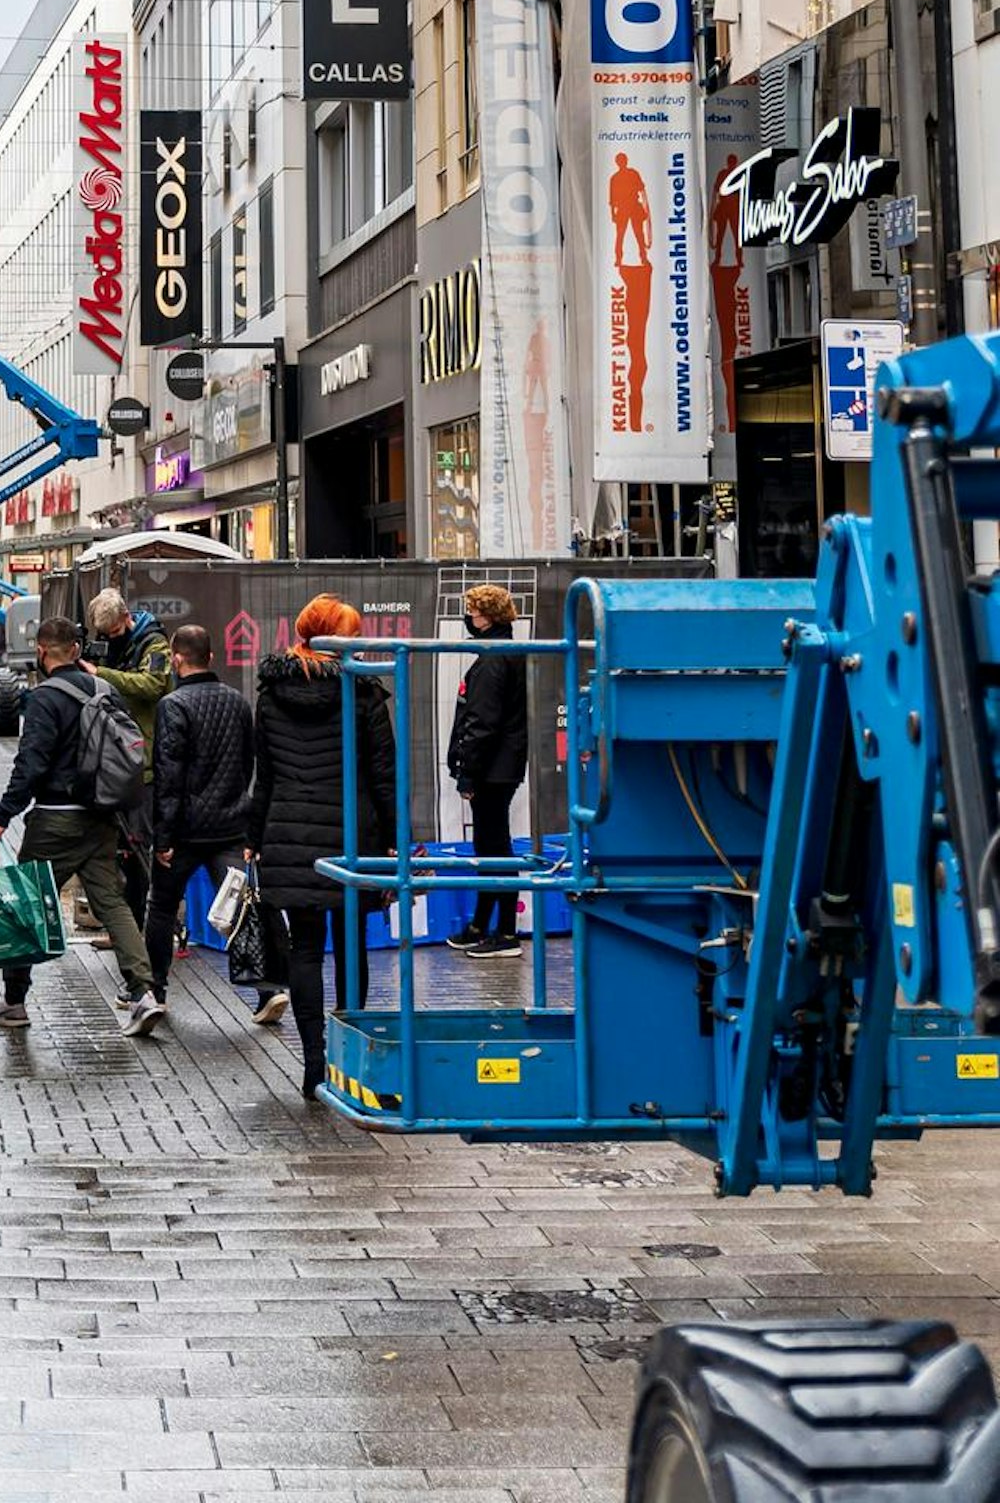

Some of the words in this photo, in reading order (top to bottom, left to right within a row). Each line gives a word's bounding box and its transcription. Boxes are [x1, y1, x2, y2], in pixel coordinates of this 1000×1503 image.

[309, 63, 403, 83] CALLAS
[594, 73, 693, 84] 0221.9704190
[647, 95, 686, 106] aufzug
[80, 40, 122, 180] Markt
[598, 131, 691, 141] industrieklettern
[620, 112, 669, 122] technik
[720, 147, 796, 246] Thomas
[792, 106, 883, 245] Sabo
[155, 136, 187, 318] GEOX
[80, 211, 122, 364] Media
[611, 286, 625, 347] WERK
[668, 152, 691, 432] www.odendahl.koeln
[612, 362, 626, 432] KRAFT
[363, 602, 411, 613] BAUHERR
